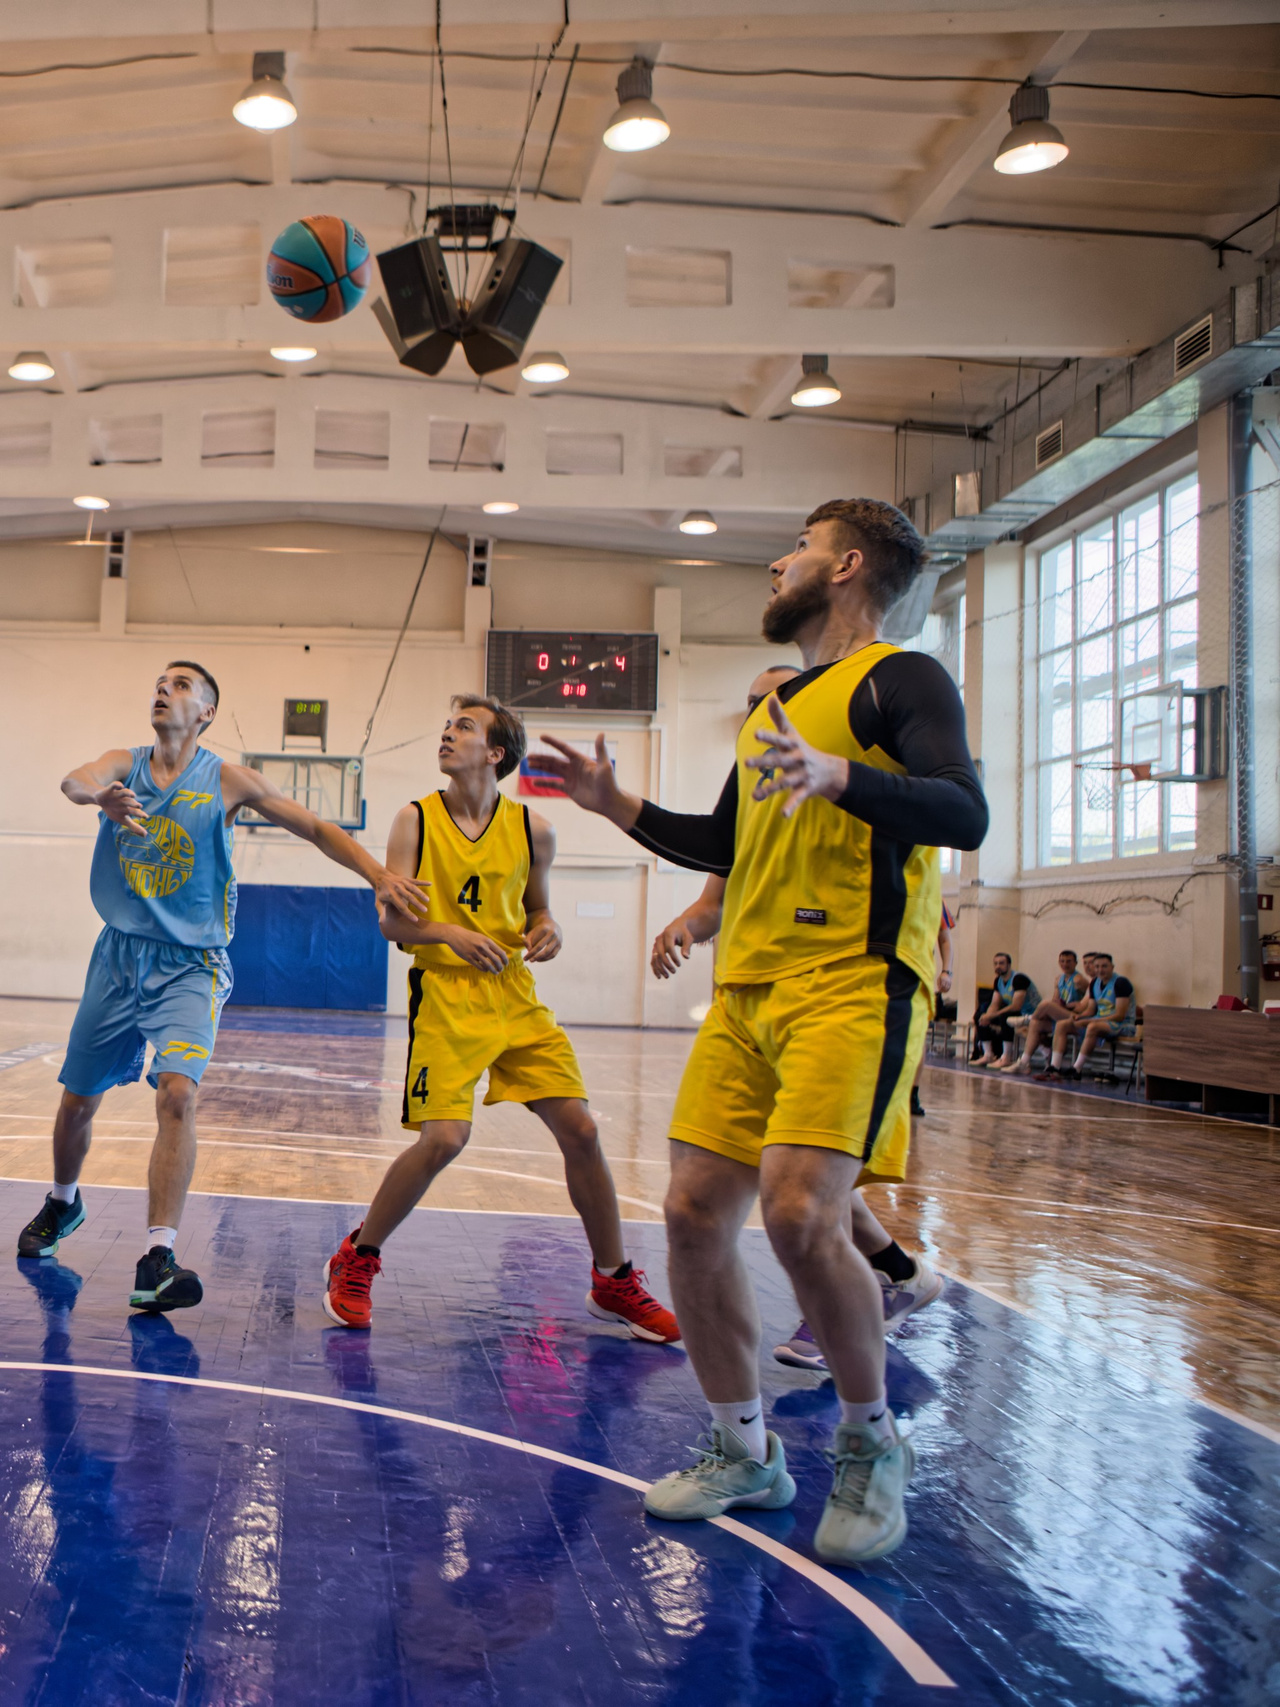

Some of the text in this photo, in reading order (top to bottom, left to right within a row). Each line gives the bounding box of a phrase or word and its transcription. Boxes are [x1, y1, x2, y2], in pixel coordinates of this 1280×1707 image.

[538, 653, 549, 671] 0
[615, 656, 626, 672] 4
[457, 875, 482, 913] 4
[411, 1066, 429, 1105] 4
